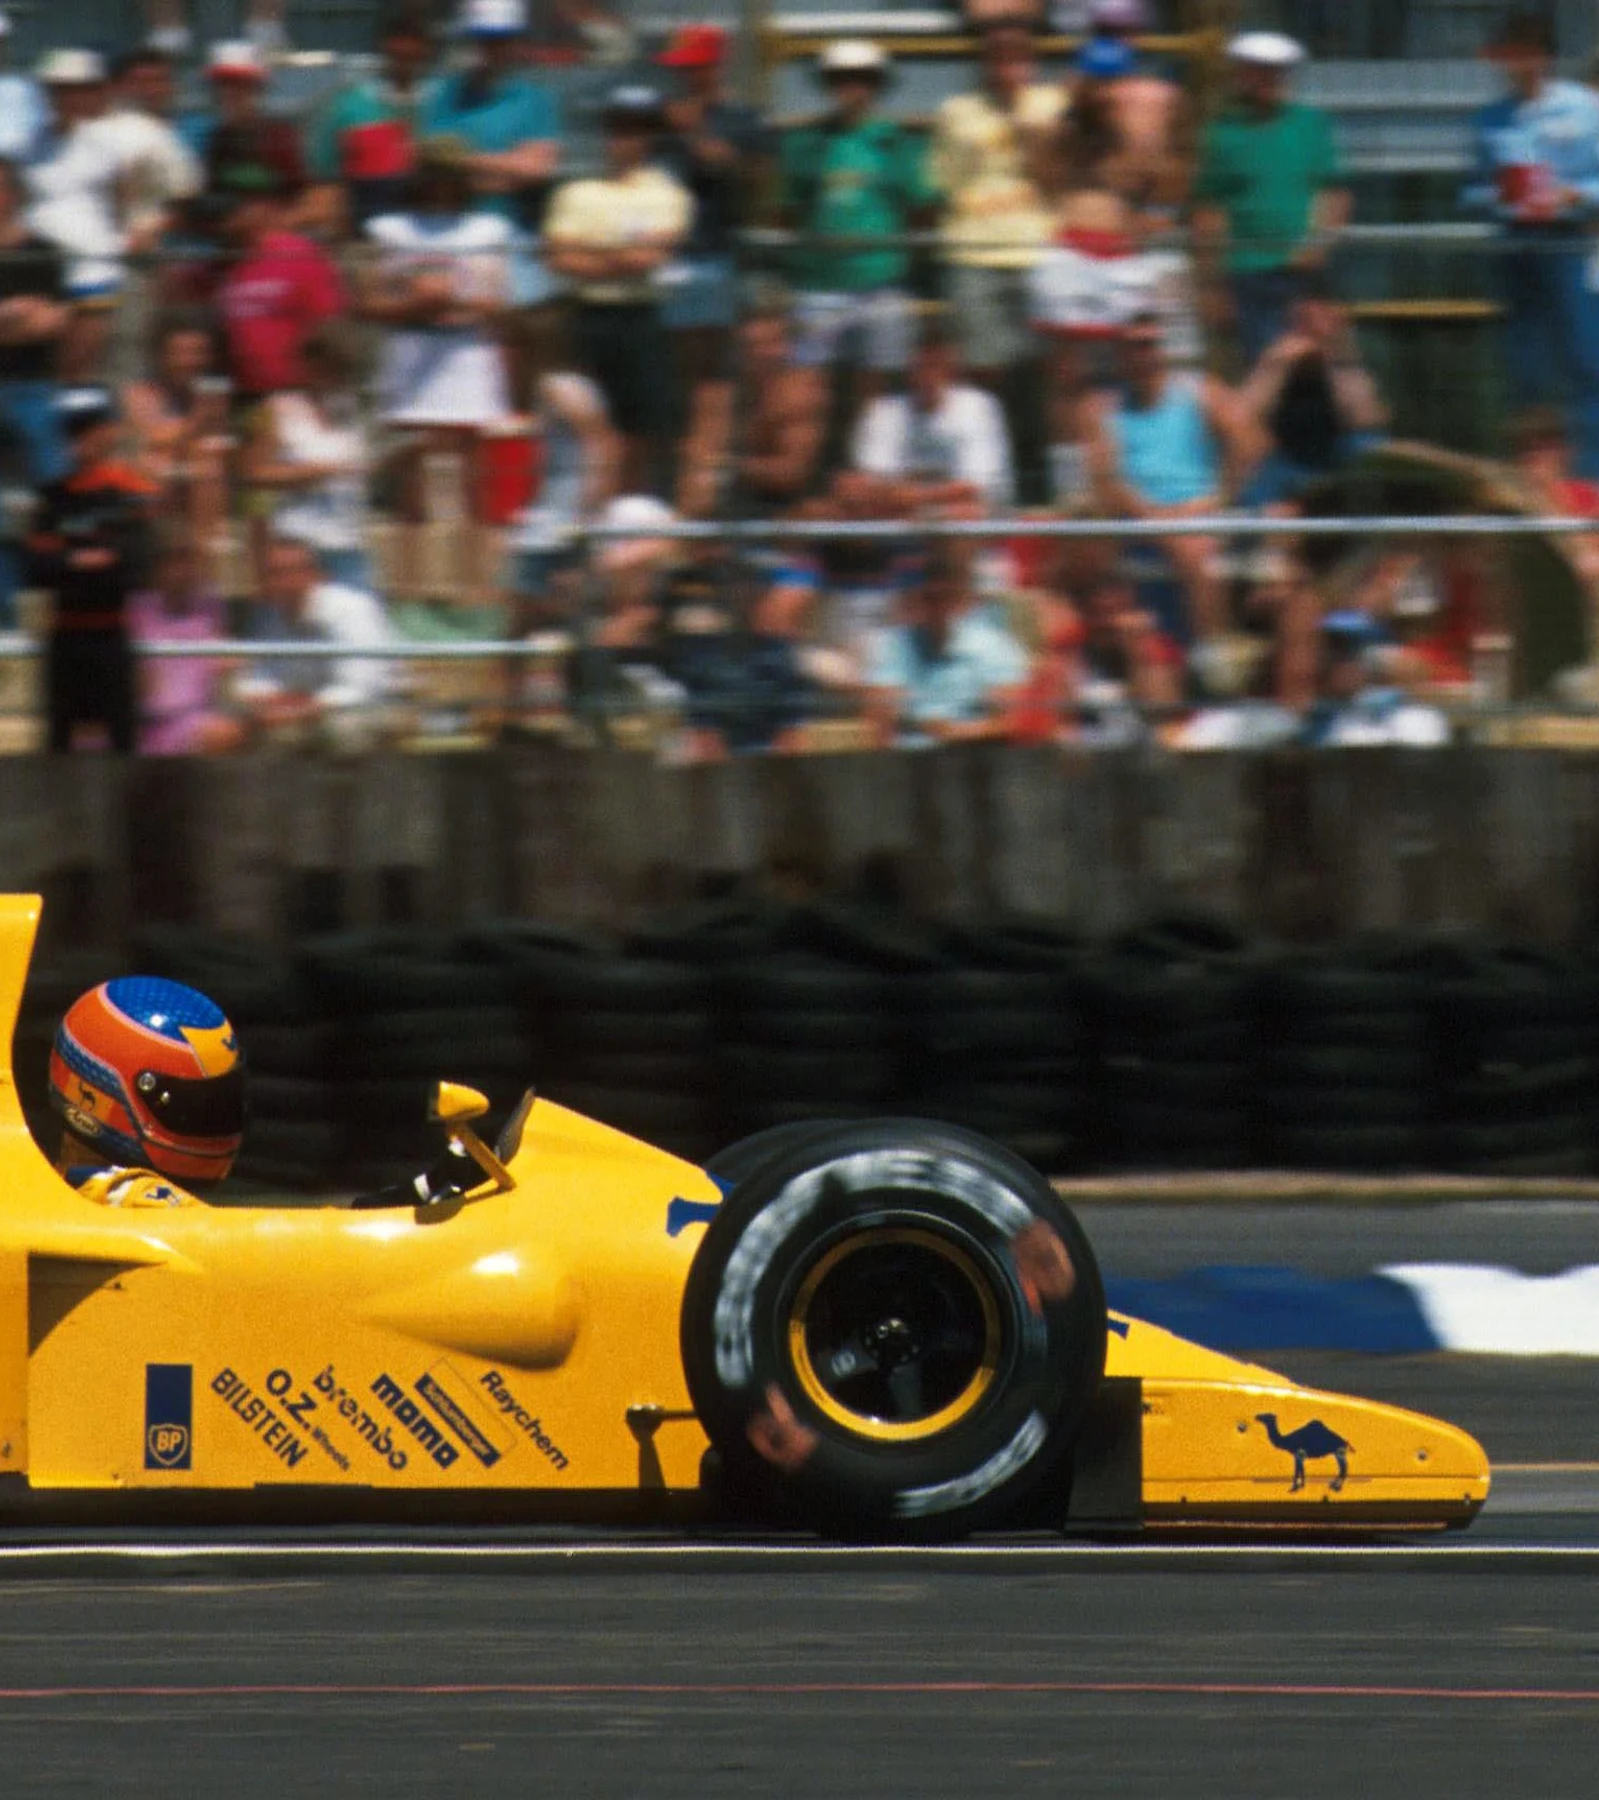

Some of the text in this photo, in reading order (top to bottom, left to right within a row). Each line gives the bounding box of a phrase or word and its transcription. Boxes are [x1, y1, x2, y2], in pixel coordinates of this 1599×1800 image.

[157, 1430, 182, 1452] BP
[211, 1368, 308, 1467] BILSTEIN
[313, 1364, 407, 1470] brembo
[480, 1370, 569, 1471] Raychem
